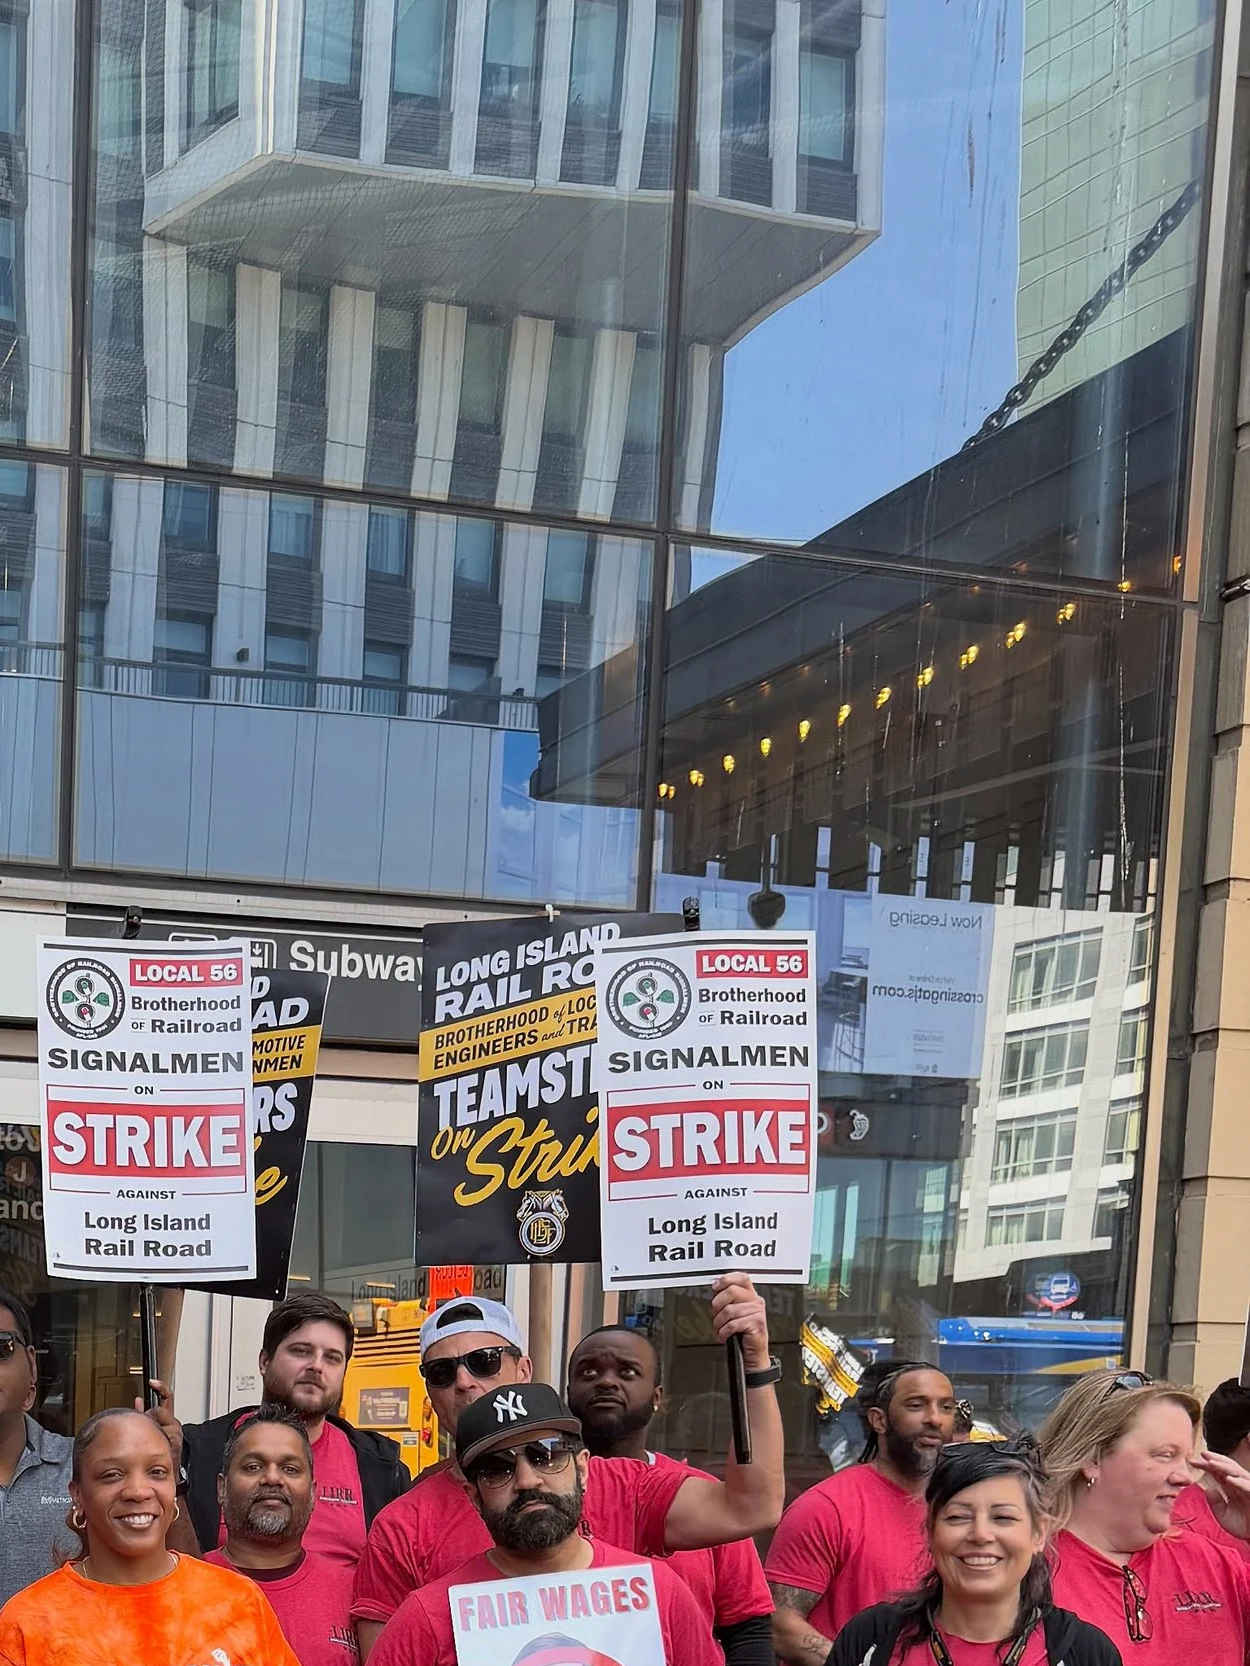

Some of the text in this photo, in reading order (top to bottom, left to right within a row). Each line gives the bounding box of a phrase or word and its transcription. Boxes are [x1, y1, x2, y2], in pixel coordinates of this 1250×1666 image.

[436, 922, 620, 991] LONG ISLAND
[702, 955, 802, 973] LOCAL 56
[135, 964, 237, 982] LOCAL 56
[435, 974, 531, 1024] RAIL
[542, 955, 597, 995] RO
[699, 988, 806, 1003] Brotherhood
[131, 996, 241, 1011] Brotherhood
[252, 997, 309, 1028] AD
[131, 1018, 241, 1033] OF Railroad
[435, 1006, 548, 1050] BROTHERHOOD
[553, 1003, 566, 1024] of
[720, 1011, 807, 1025] Railroad
[252, 1035, 307, 1054] MOTIVE
[434, 1030, 538, 1070] ENGINEERS
[541, 1024, 564, 1042] and
[48, 1048, 243, 1073] SIGNALMEN
[608, 1046, 808, 1073] SIGNALMEN
[134, 1086, 154, 1095] ON
[434, 1044, 598, 1131] TEAMST
[703, 1080, 724, 1089] ON
[53, 1112, 241, 1167] STRIKE
[431, 1126, 475, 1160] On
[613, 1111, 806, 1171] STRIKE
[454, 1107, 600, 1206] Stri
[13, 1162, 27, 1183] J
[117, 1189, 176, 1199] AGAINST
[684, 1188, 747, 1199] AGAINST
[84, 1212, 210, 1233] Long Island
[649, 1212, 777, 1235] Long Island
[85, 1238, 211, 1257] Rail Road
[649, 1240, 776, 1262] Rail Road
[493, 1391, 527, 1423] NY
[458, 1576, 650, 1632] FAIR WAGES
